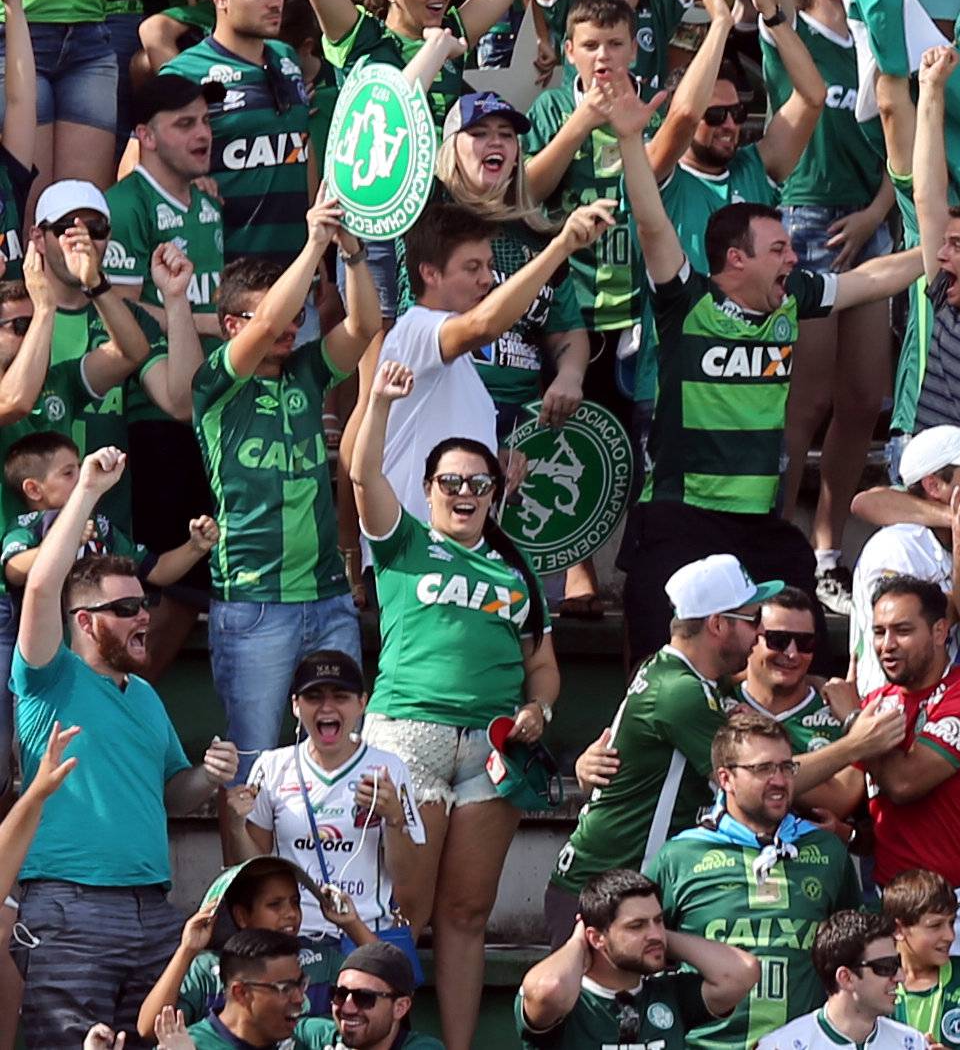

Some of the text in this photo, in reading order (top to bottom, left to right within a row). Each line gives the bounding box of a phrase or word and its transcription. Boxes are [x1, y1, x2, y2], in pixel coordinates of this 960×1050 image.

[223, 133, 308, 170] CAIX
[702, 346, 792, 378] CAIX
[565, 406, 627, 461] OCIAÇÃO
[546, 462, 629, 570] CHAPECOENSE
[694, 856, 735, 873] aurora
